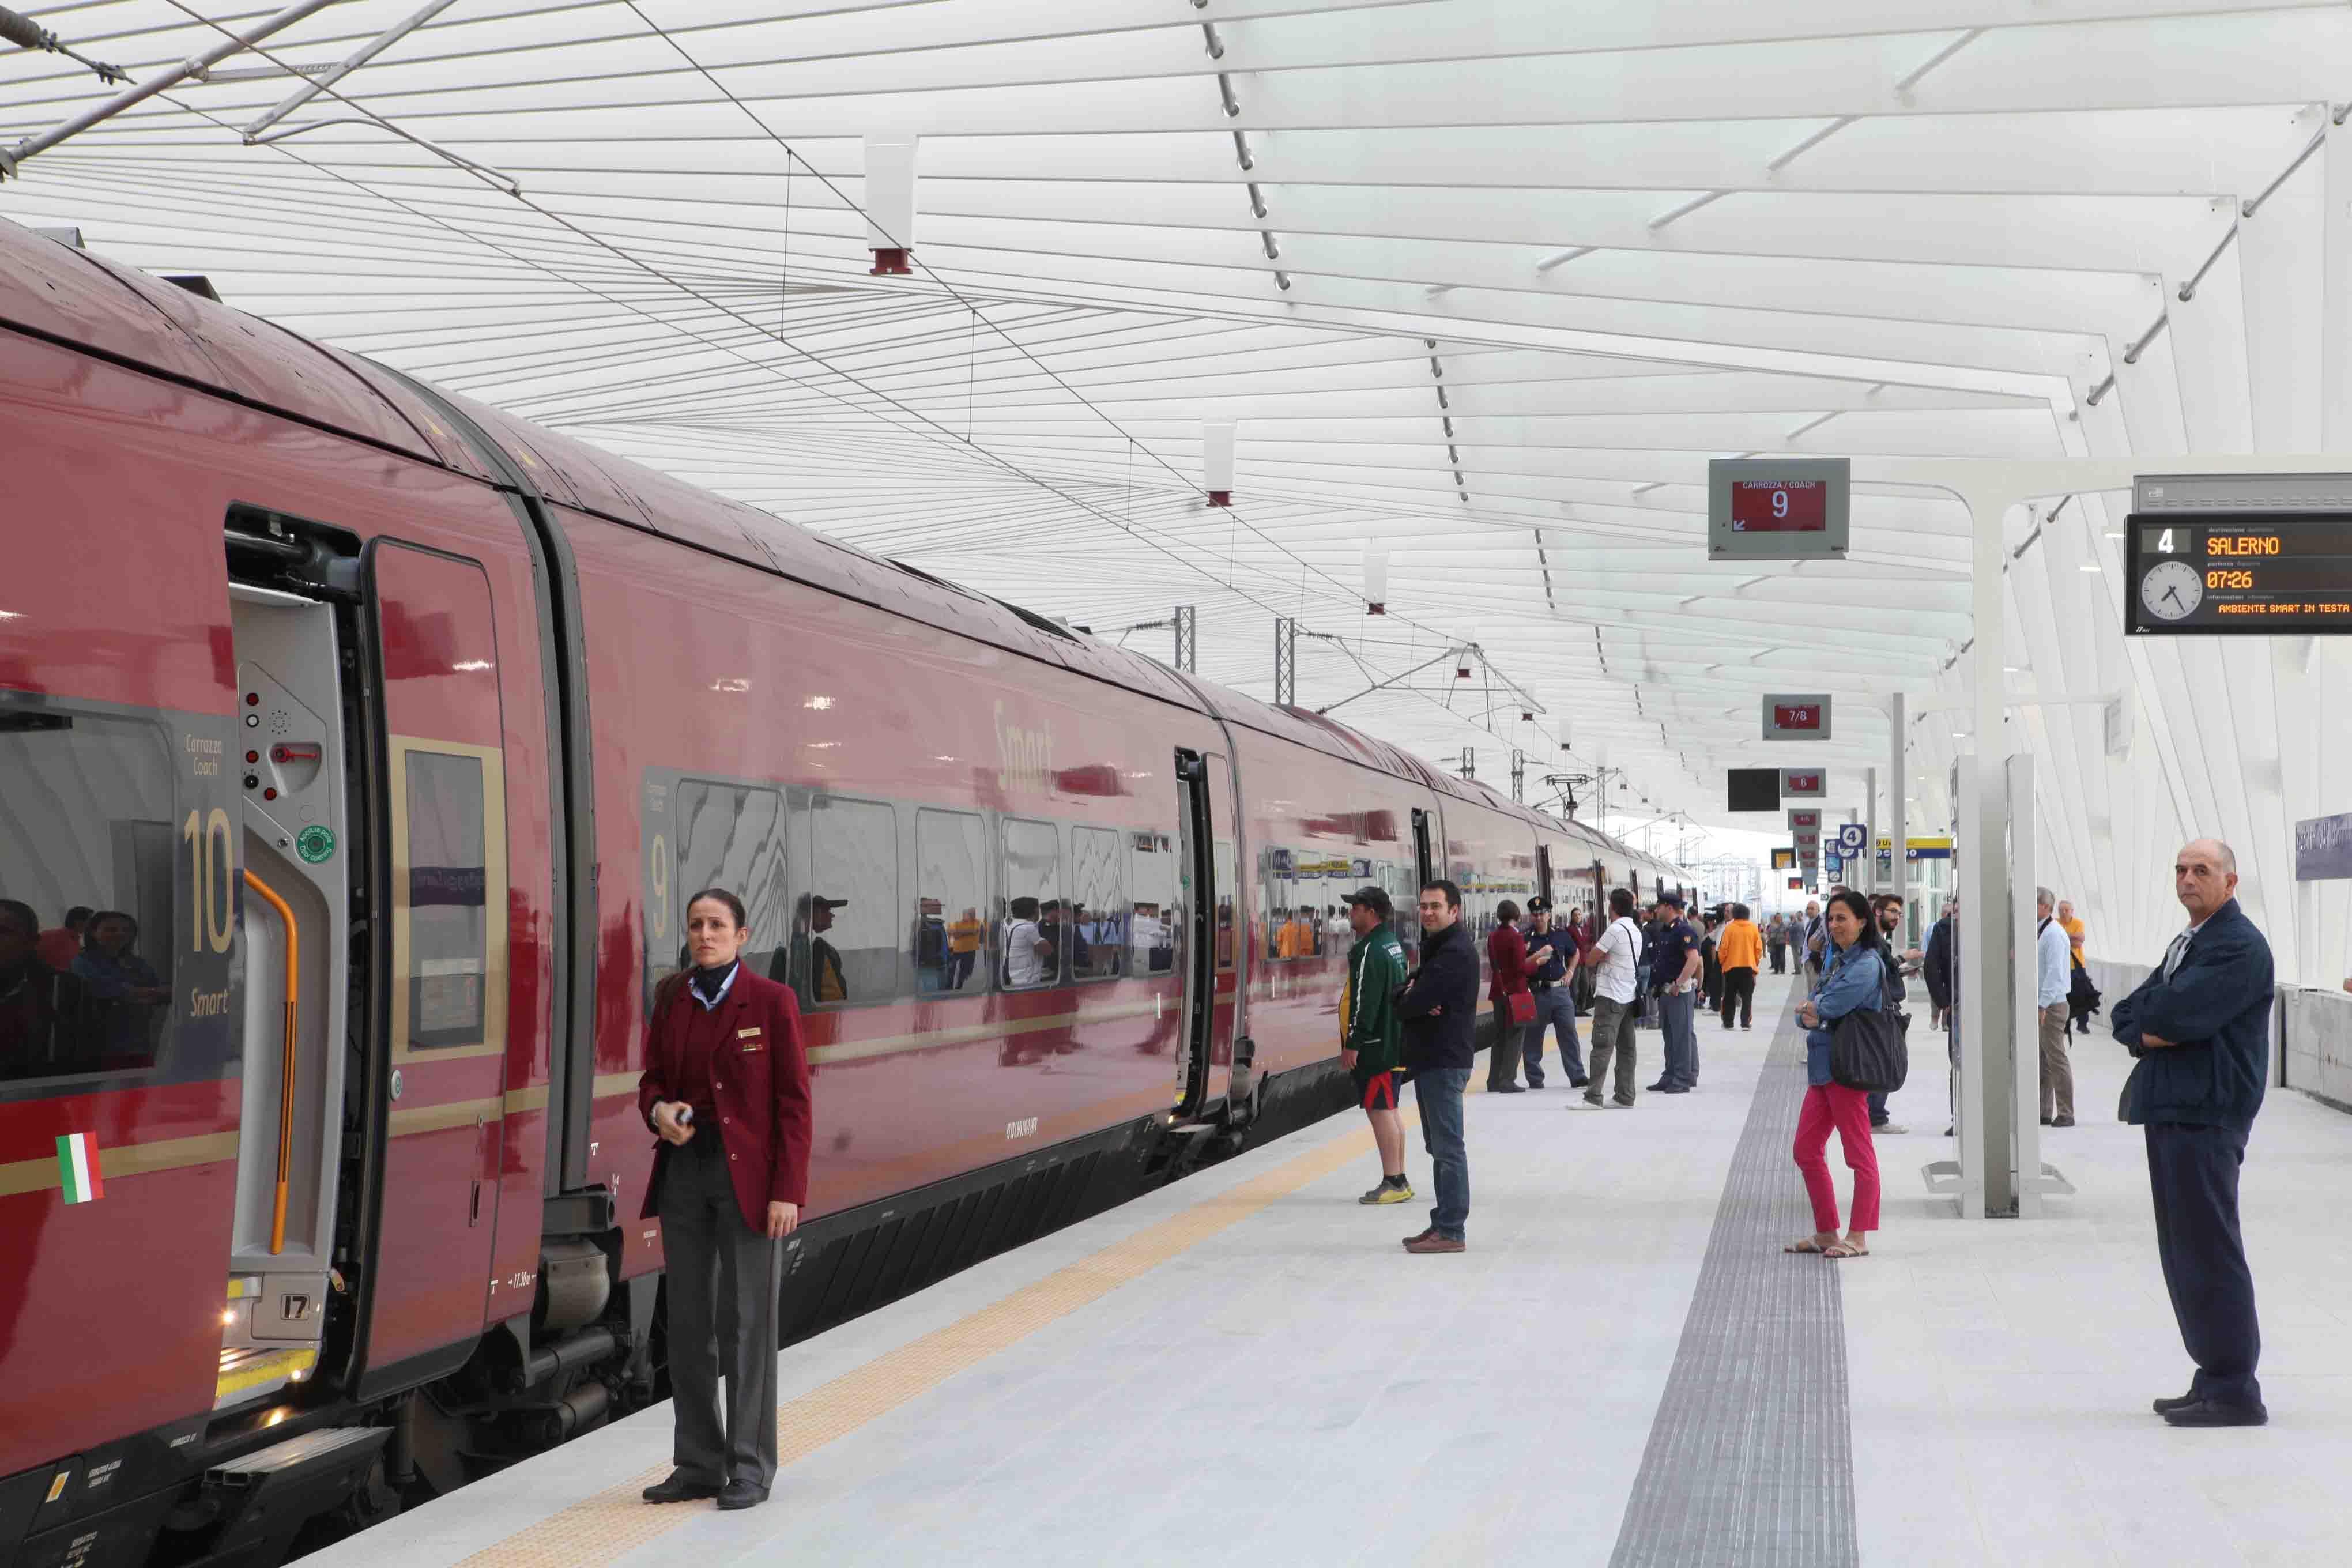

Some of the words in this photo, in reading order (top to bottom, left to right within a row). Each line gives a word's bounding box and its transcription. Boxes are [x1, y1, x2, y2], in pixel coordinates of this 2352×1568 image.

[1789, 481, 1815, 489] COACH
[1772, 491, 1788, 517] 9
[2158, 529, 2174, 553] 4
[2207, 537, 2279, 555] SALERNO
[2207, 571, 2252, 588] 07:26
[2219, 604, 2266, 613] AMBIENTE
[2270, 604, 2300, 613] SMART
[2304, 604, 2315, 613] IN
[2319, 604, 2350, 613] TESTA
[1789, 710, 1807, 722] 7/8
[194, 757, 217, 775] Coach
[1847, 831, 1857, 842] 4
[184, 808, 233, 954] 10
[651, 834, 668, 939] 9
[190, 987, 229, 1018] Smart
[284, 1296, 307, 1320] 17
